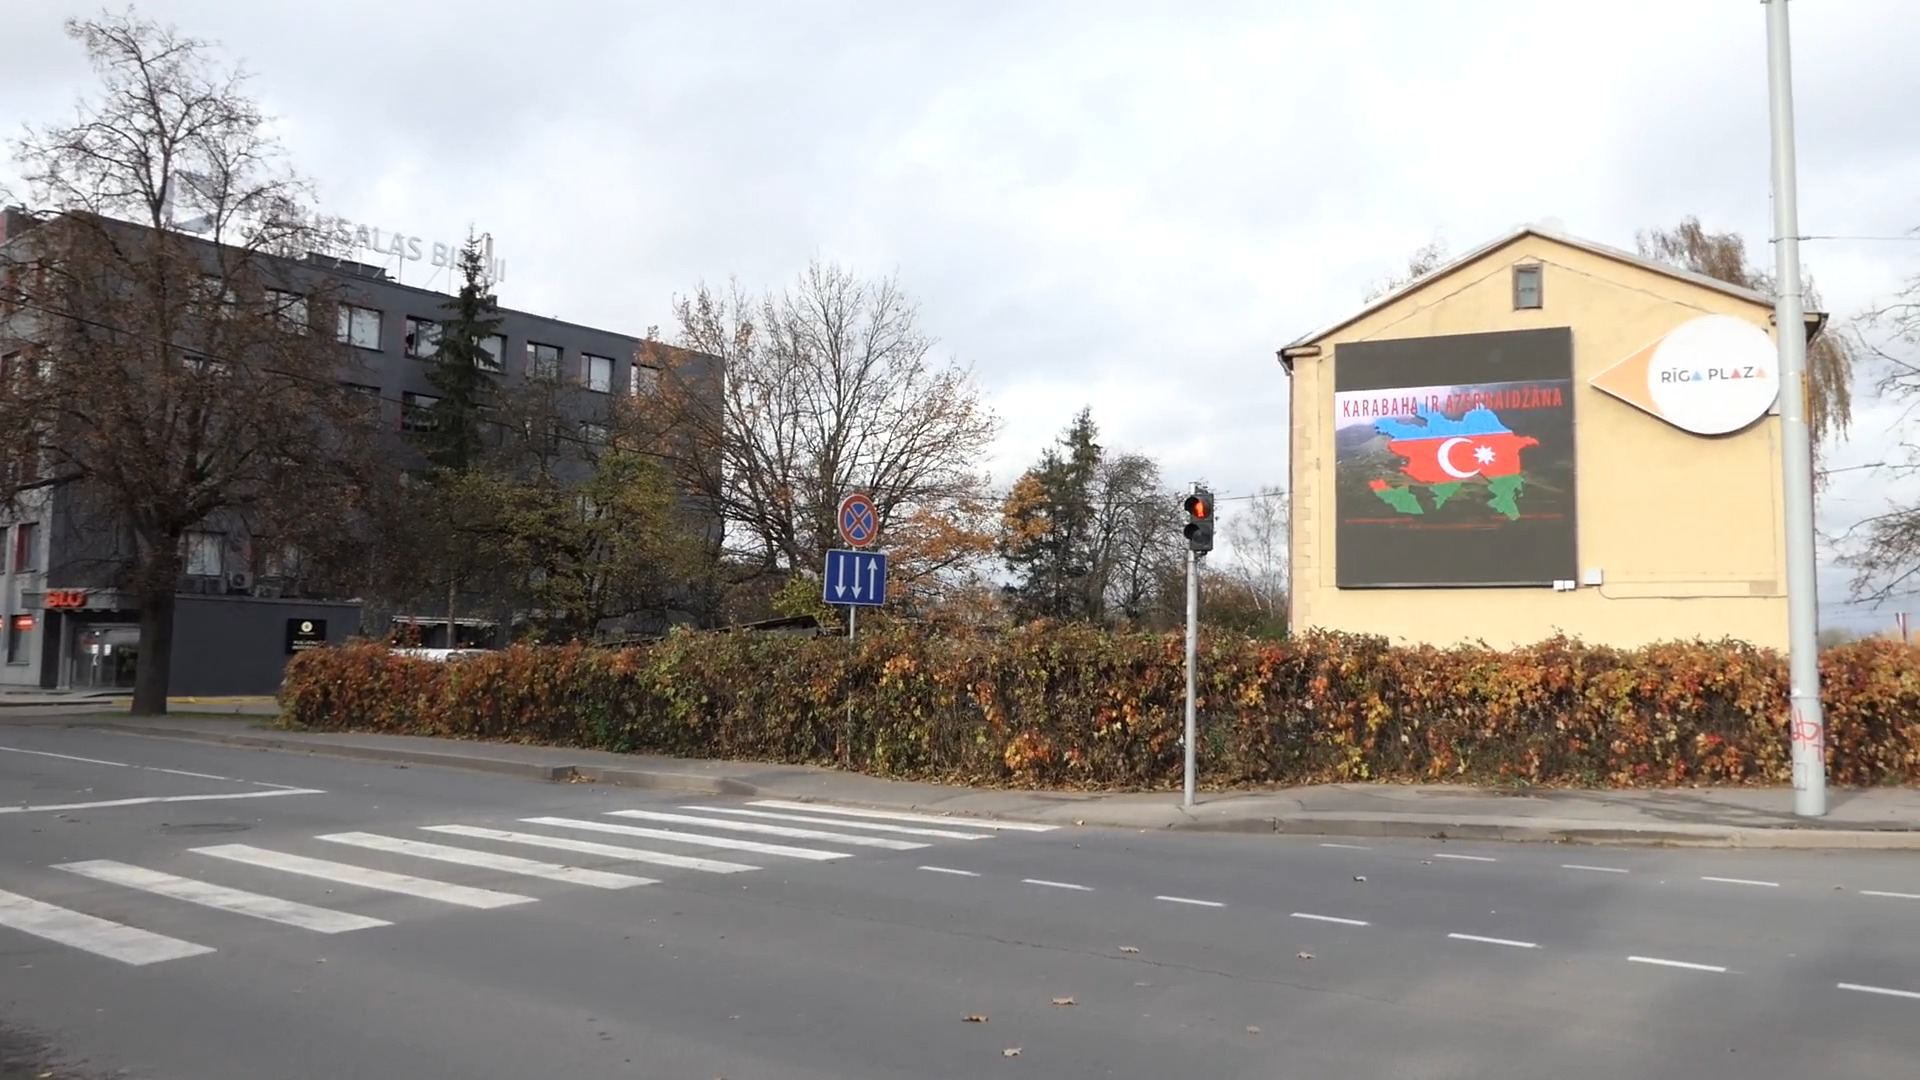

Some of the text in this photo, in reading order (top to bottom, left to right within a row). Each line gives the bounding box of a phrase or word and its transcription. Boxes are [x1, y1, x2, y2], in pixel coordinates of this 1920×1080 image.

[1708, 365, 1767, 380] PLAZA
[1343, 395, 1419, 418] KARABAHA
[1424, 394, 1440, 413] IR
